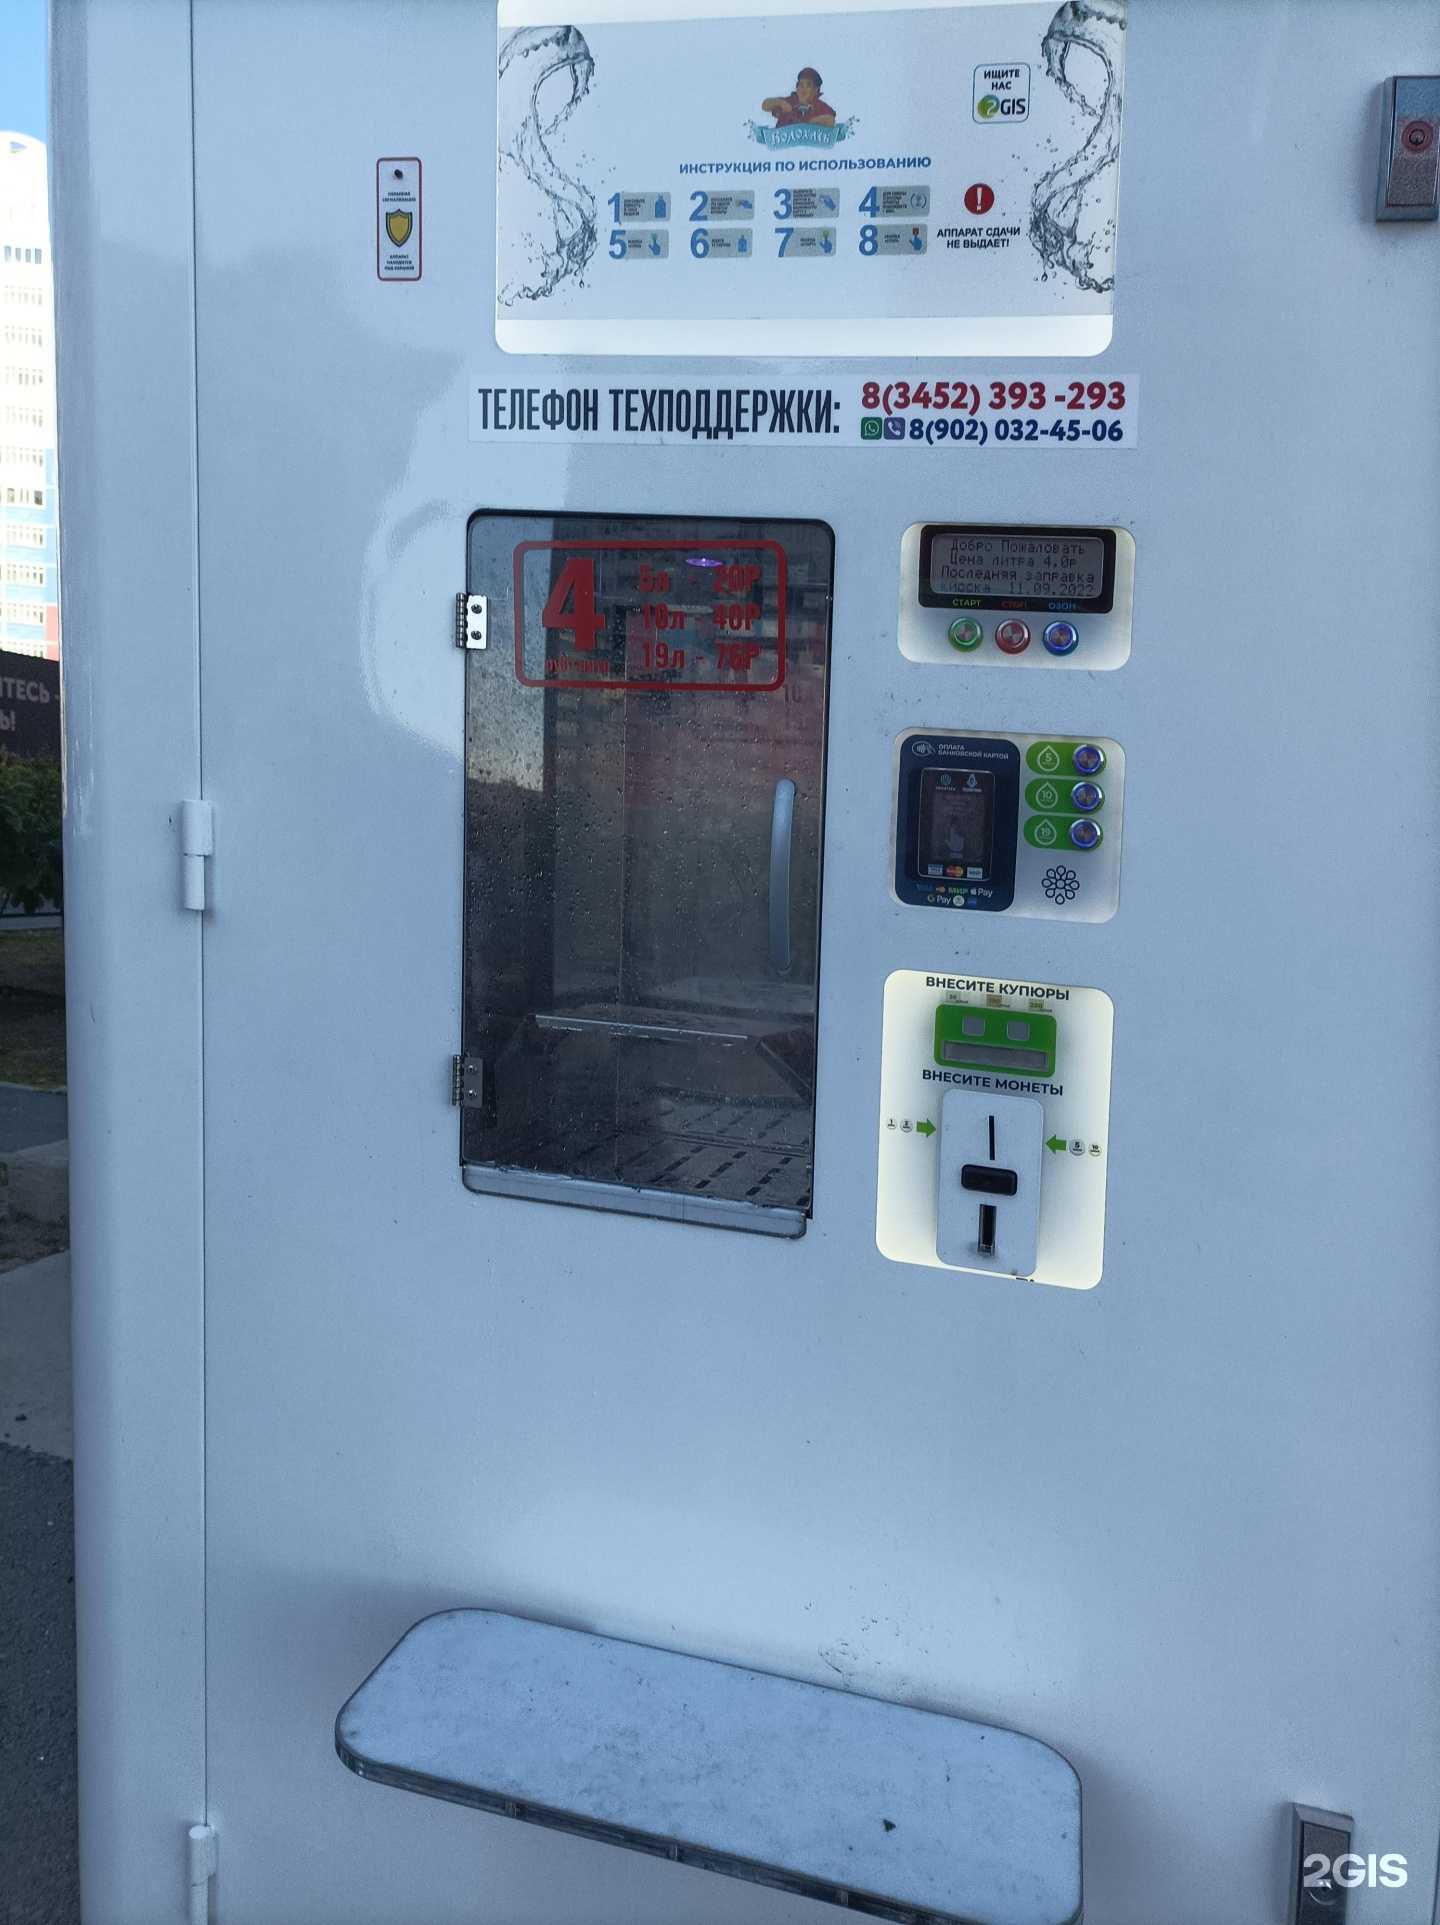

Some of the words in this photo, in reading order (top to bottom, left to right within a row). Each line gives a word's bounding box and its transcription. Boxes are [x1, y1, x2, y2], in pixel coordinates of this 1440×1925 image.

[984, 69, 1020, 80] ИЩИТЕ
[991, 81, 1012, 91] НАС
[679, 162, 771, 176] ИНСТРУКЦИЯ
[775, 161, 795, 173] ПО
[799, 157, 932, 172] ИСПОЛЬЗОВАНИЮ
[608, 192, 621, 222] 1
[689, 191, 708, 221] 2
[773, 188, 792, 220] 3
[858, 186, 880, 218] 4
[609, 230, 627, 259] 5
[690, 228, 710, 259] 6
[774, 227, 794, 257] 7
[859, 225, 878, 256] 8
[937, 228, 984, 238] АППАРАТ
[986, 227, 1021, 238] СДАЧИ
[947, 239, 961, 249] НЕ
[963, 238, 1010, 249] ВЫДАЕТ!
[862, 381, 981, 416] 8(3452)
[988, 381, 1047, 410] 393
[1054, 381, 1126, 411] -293
[478, 388, 599, 432] ТЕЛЕФОН
[608, 389, 841, 440] ТЕХПОДДЕРЖКИ:
[909, 418, 988, 446] 8(902)
[995, 419, 1124, 442] 032-45-06
[950, 552, 984, 566] Цена
[992, 555, 1034, 567] литра
[951, 538, 992, 553] Добро
[1001, 539, 1085, 555] Пожаловать
[941, 566, 1017, 581] Последняя
[1025, 569, 1095, 584] заправка
[543, 557, 606, 650] 4
[642, 603, 686, 630] 10л
[952, 599, 981, 607] СТАРТ
[642, 642, 686, 670] 19л
[0, 677, 50, 704] ТЕСЬ
[938, 743, 965, 751] ОПЛАТА
[1041, 790, 1053, 800] 10
[926, 976, 995, 993] ВНЕСИТЕ
[999, 983, 1070, 1001] КУПЮРЫ
[923, 1069, 991, 1088] ВНЕСИТЕ
[995, 1079, 1063, 1096] МОНЕТЫ
